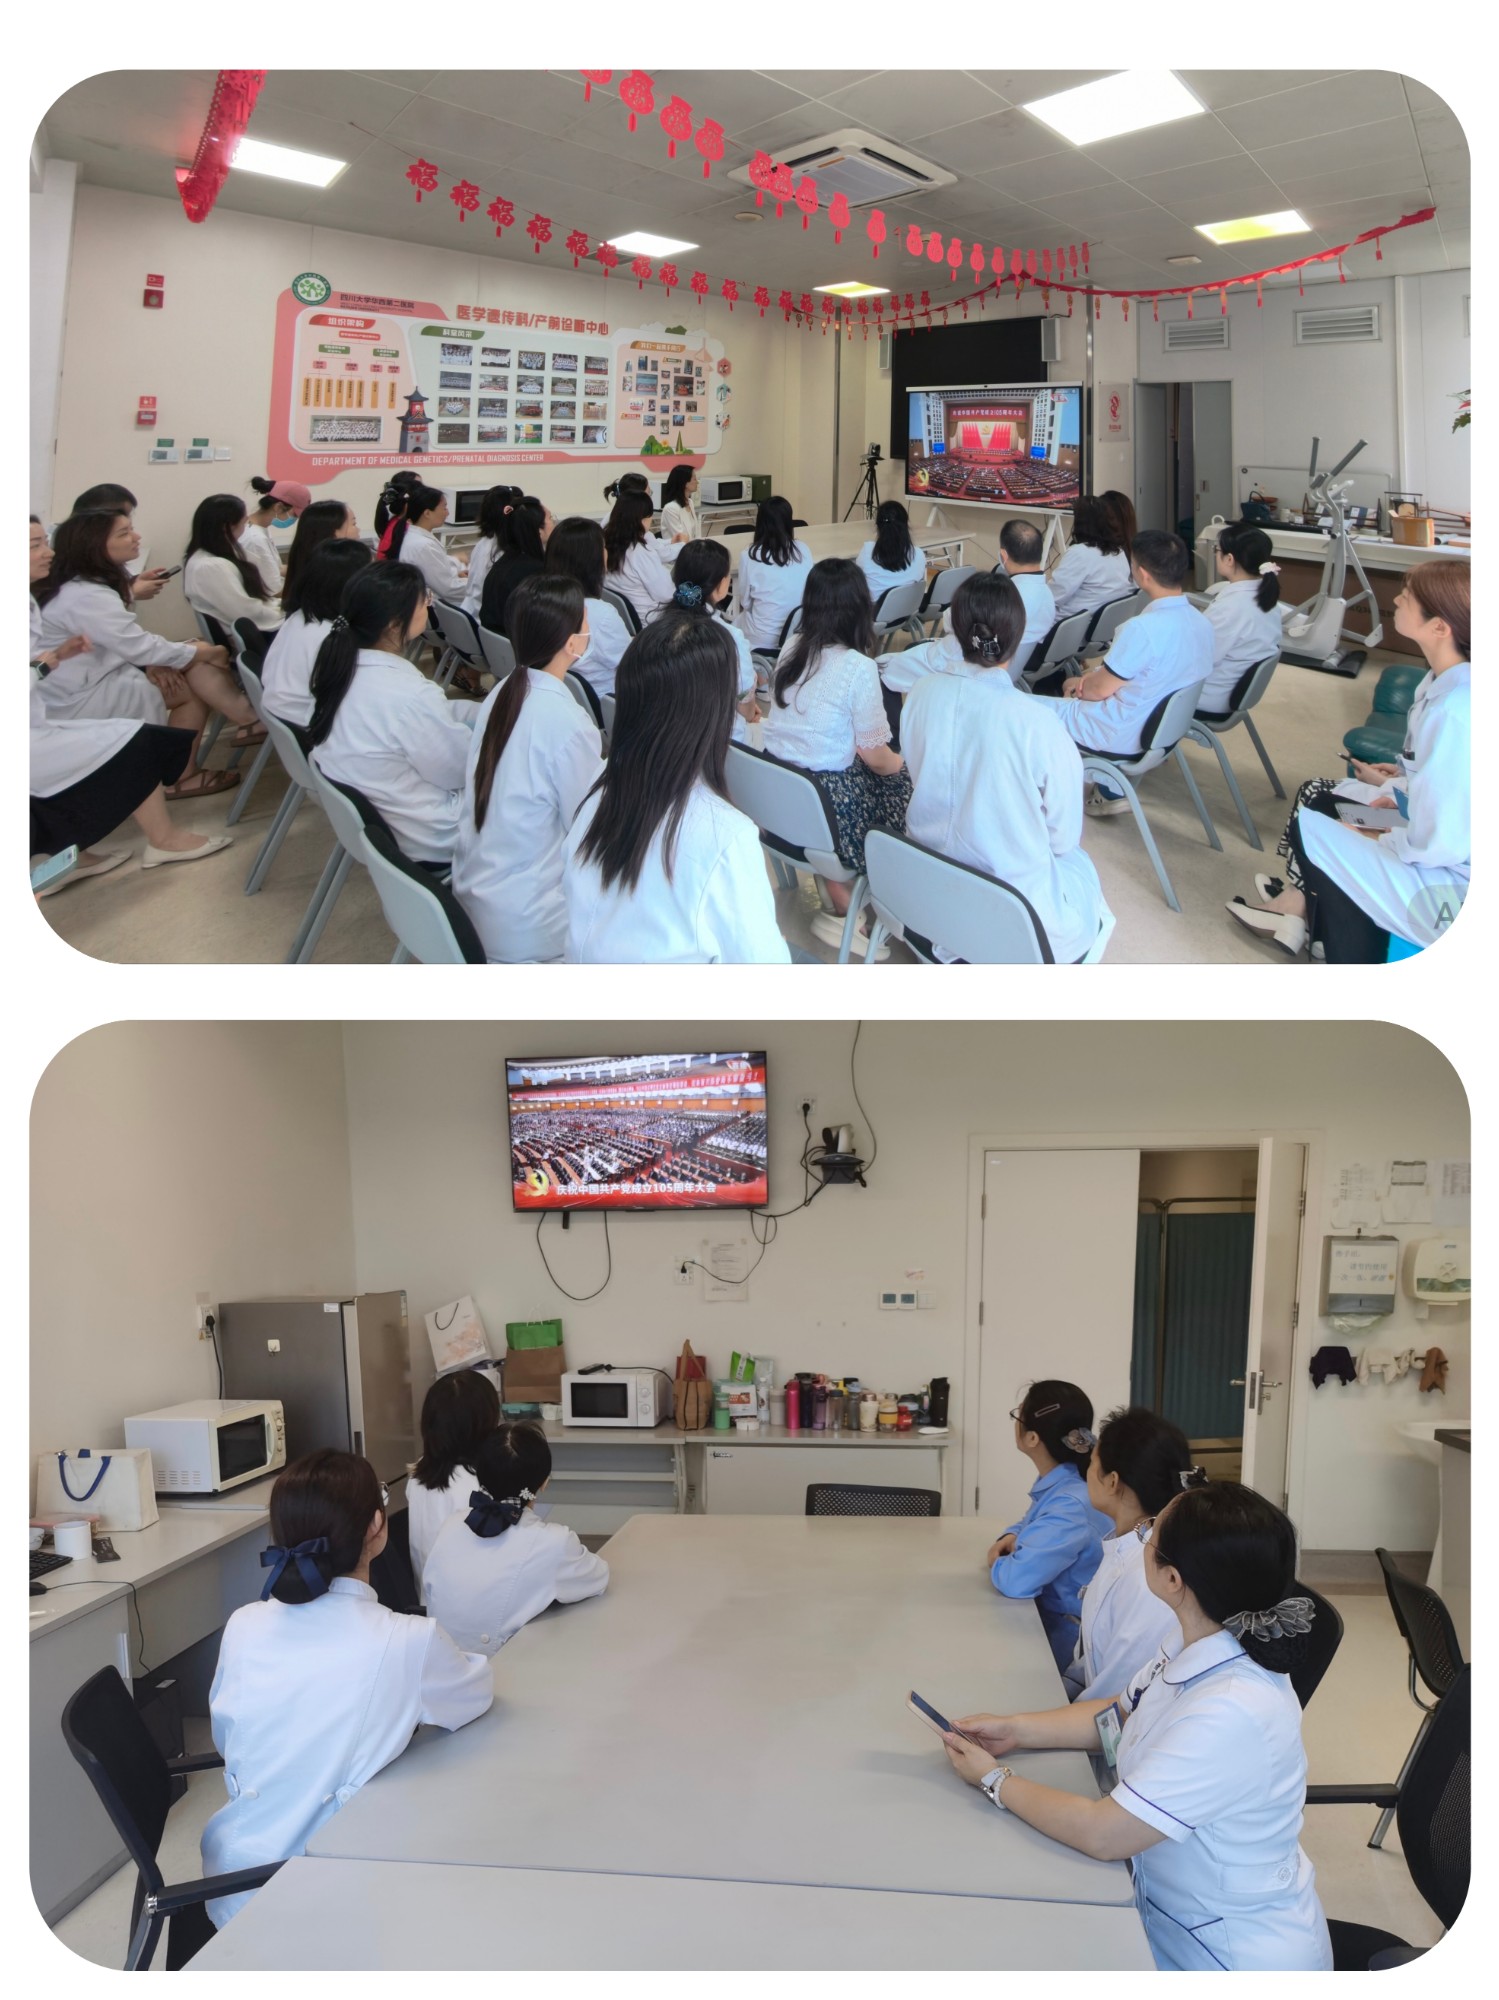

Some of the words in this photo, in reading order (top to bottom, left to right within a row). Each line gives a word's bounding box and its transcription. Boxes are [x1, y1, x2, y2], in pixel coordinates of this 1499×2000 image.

[406, 159, 439, 192] 福
[449, 180, 480, 212] 福
[486, 196, 515, 228] 福
[526, 214, 552, 243] 福
[565, 230, 590, 257] 福
[595, 241, 619, 268] 福
[631, 254, 653, 279] 福
[659, 262, 679, 287] 福
[690, 271, 710, 295] 福
[721, 279, 741, 301] 福
[340, 293, 415, 309] 四川大学华西第二医院
[328, 317, 365, 328] 组织架构
[456, 304, 609, 336] 医学遗传科/产前诊断中心
[442, 328, 473, 338] 科室风采
[312, 456, 367, 467] DEPARTMENT
[368, 456, 378, 465] OF
[379, 455, 412, 465] MEDICAL
[413, 454, 486, 464] GENETICS/PRENATAL
[486, 454, 521, 463] DIAGNOSIS
[521, 453, 545, 463] CENTER
[556, 1182, 717, 1196] 庆祝中国共产党成立105周年大会
